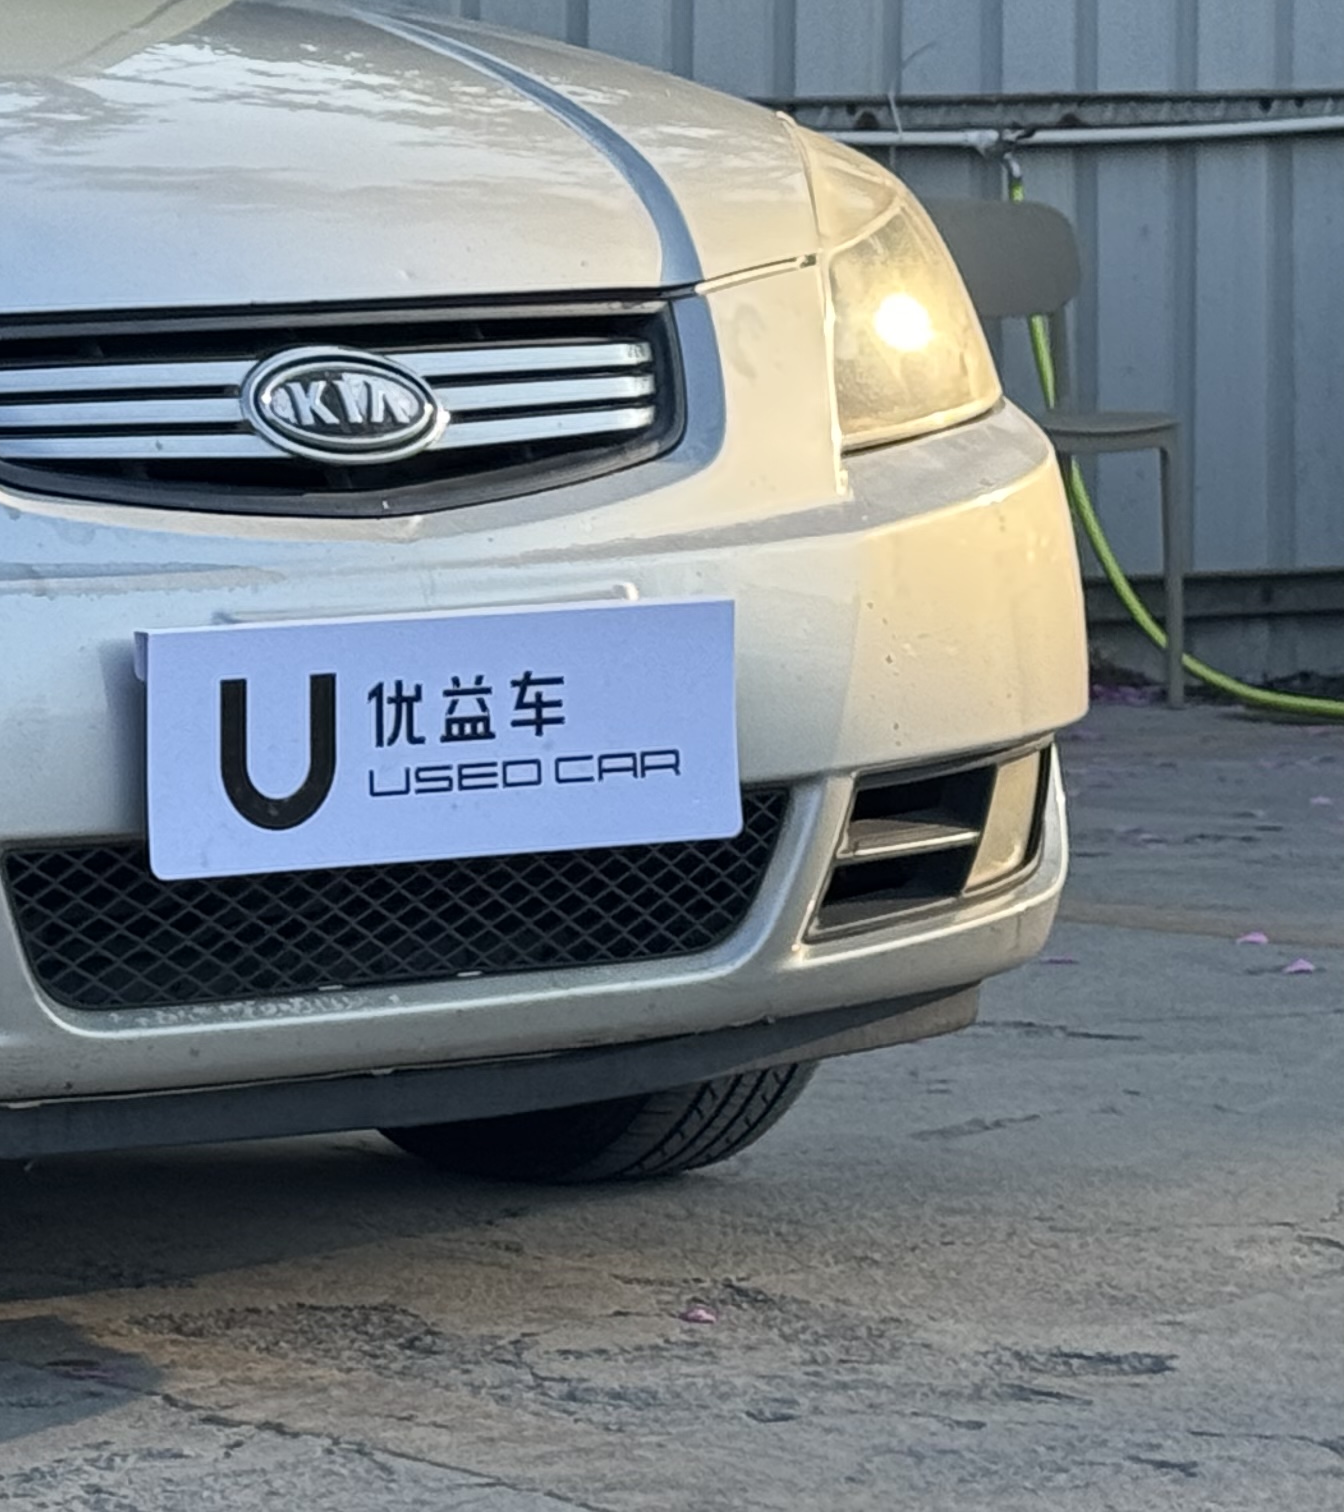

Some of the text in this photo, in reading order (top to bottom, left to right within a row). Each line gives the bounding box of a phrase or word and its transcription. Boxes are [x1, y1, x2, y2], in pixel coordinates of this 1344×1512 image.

[279, 371, 417, 426] KIA
[367, 670, 566, 748] 优益车
[219, 672, 337, 831] U
[368, 748, 681, 797] USED CAR
